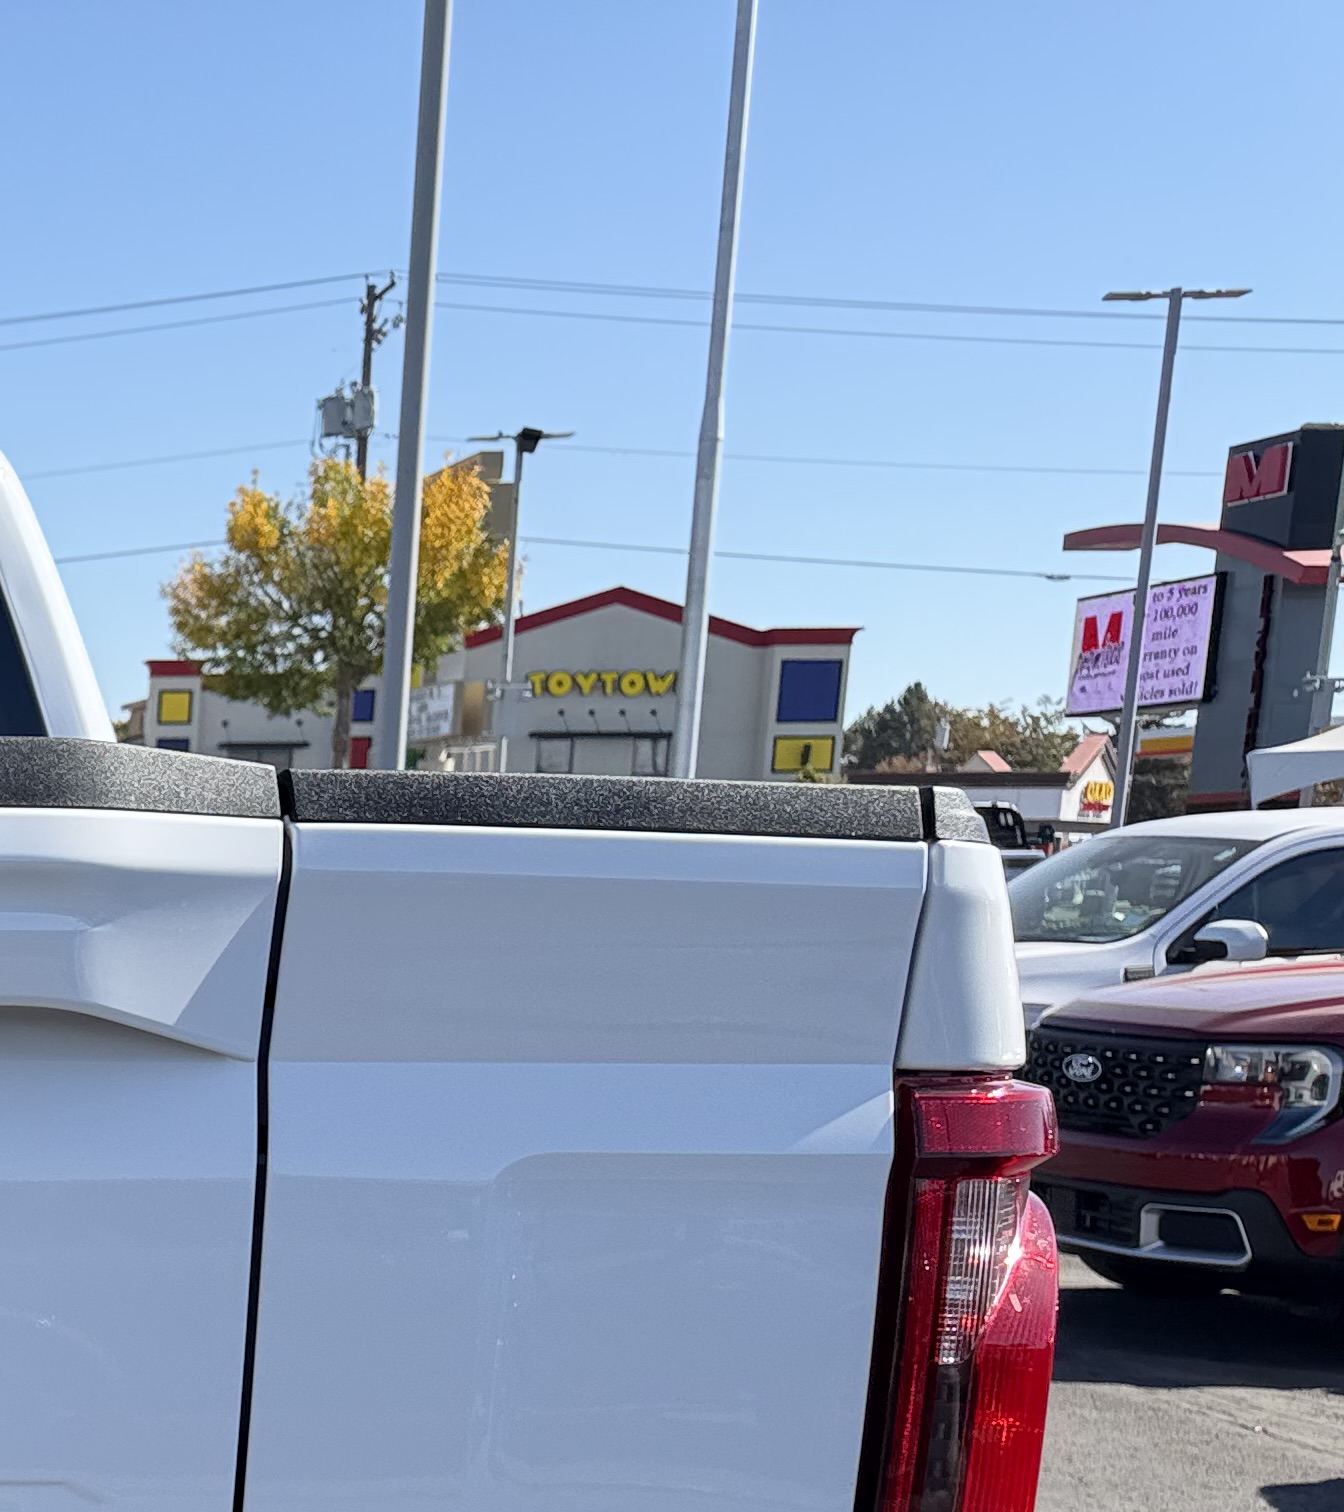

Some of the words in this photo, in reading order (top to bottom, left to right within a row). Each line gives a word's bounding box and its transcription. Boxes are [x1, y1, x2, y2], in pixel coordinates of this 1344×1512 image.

[1226, 441, 1293, 507] M
[1177, 584, 1208, 602] years
[1151, 627, 1178, 642] mile
[1142, 646, 1180, 664] rranty
[1182, 645, 1197, 657] on
[1163, 662, 1191, 679] used
[527, 670, 676, 698] TOYTOW
